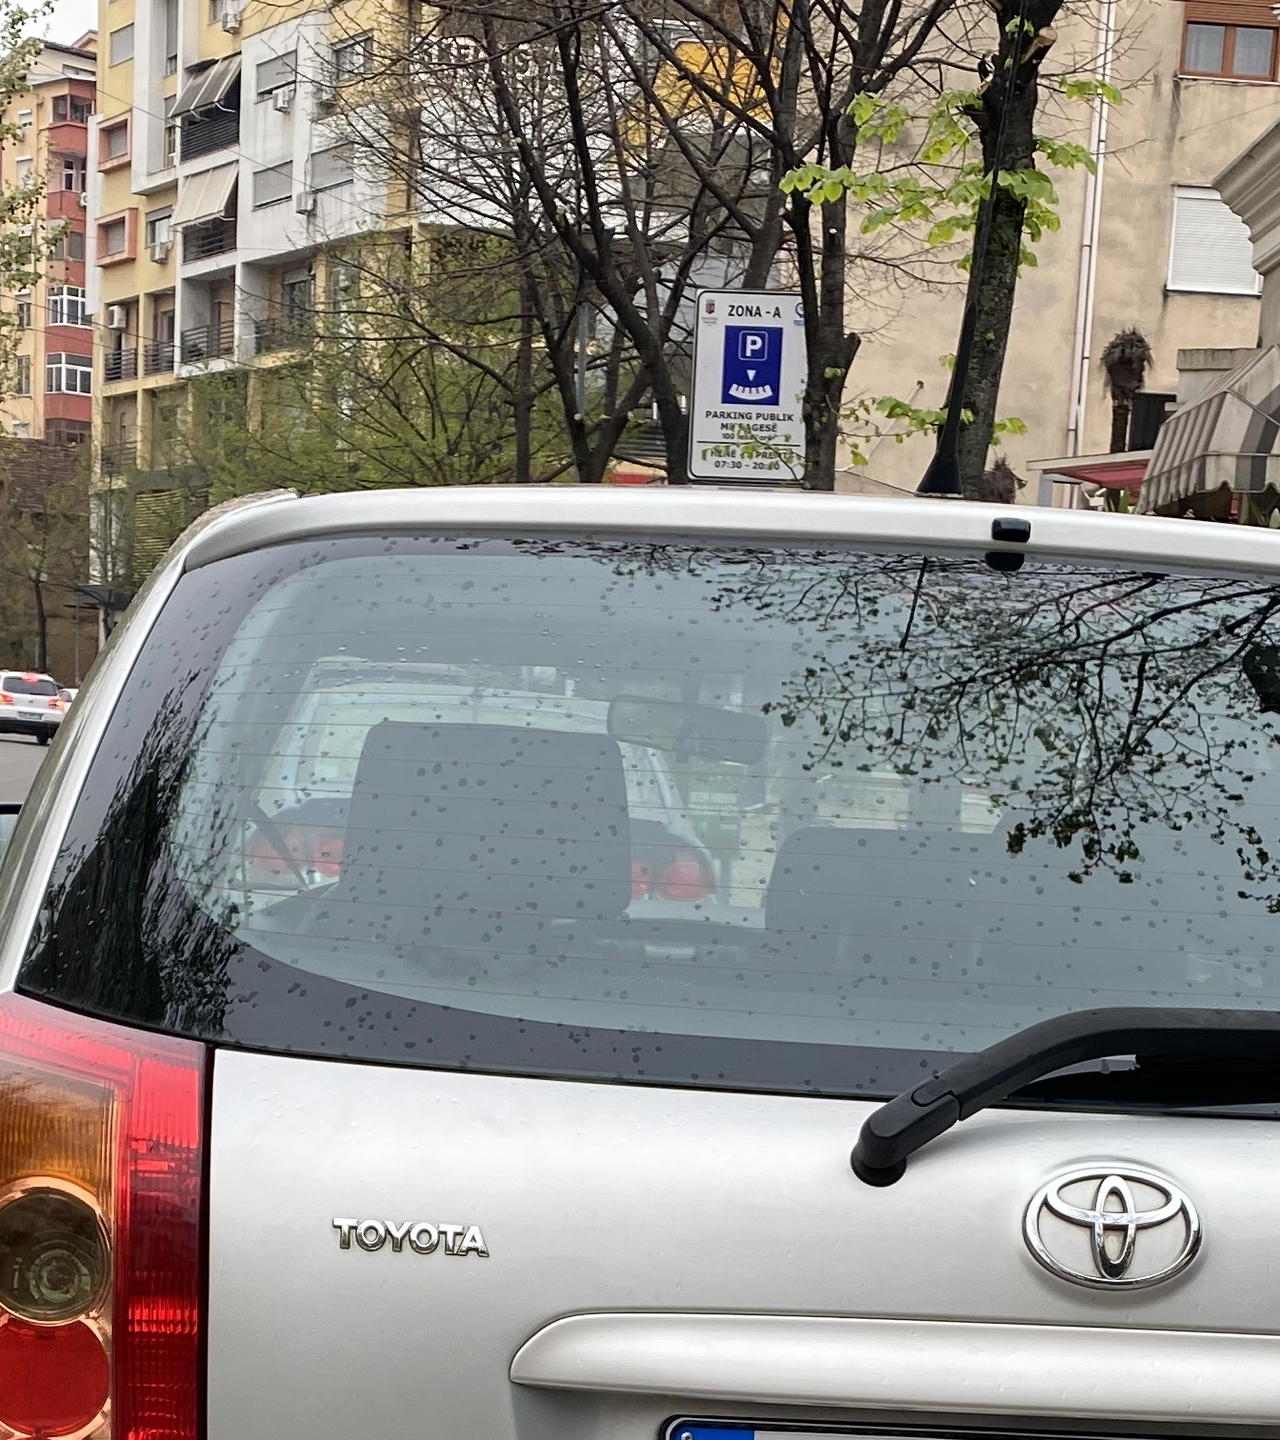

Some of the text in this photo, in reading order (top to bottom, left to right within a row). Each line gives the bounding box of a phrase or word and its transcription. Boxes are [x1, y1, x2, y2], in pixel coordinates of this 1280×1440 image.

[728, 304, 762, 318] ZONA
[745, 335, 762, 357] P
[705, 410, 794, 422] PARKING PUBLIK
[714, 460, 742, 469] 07:30
[332, 1217, 490, 1257] TOYOTA
